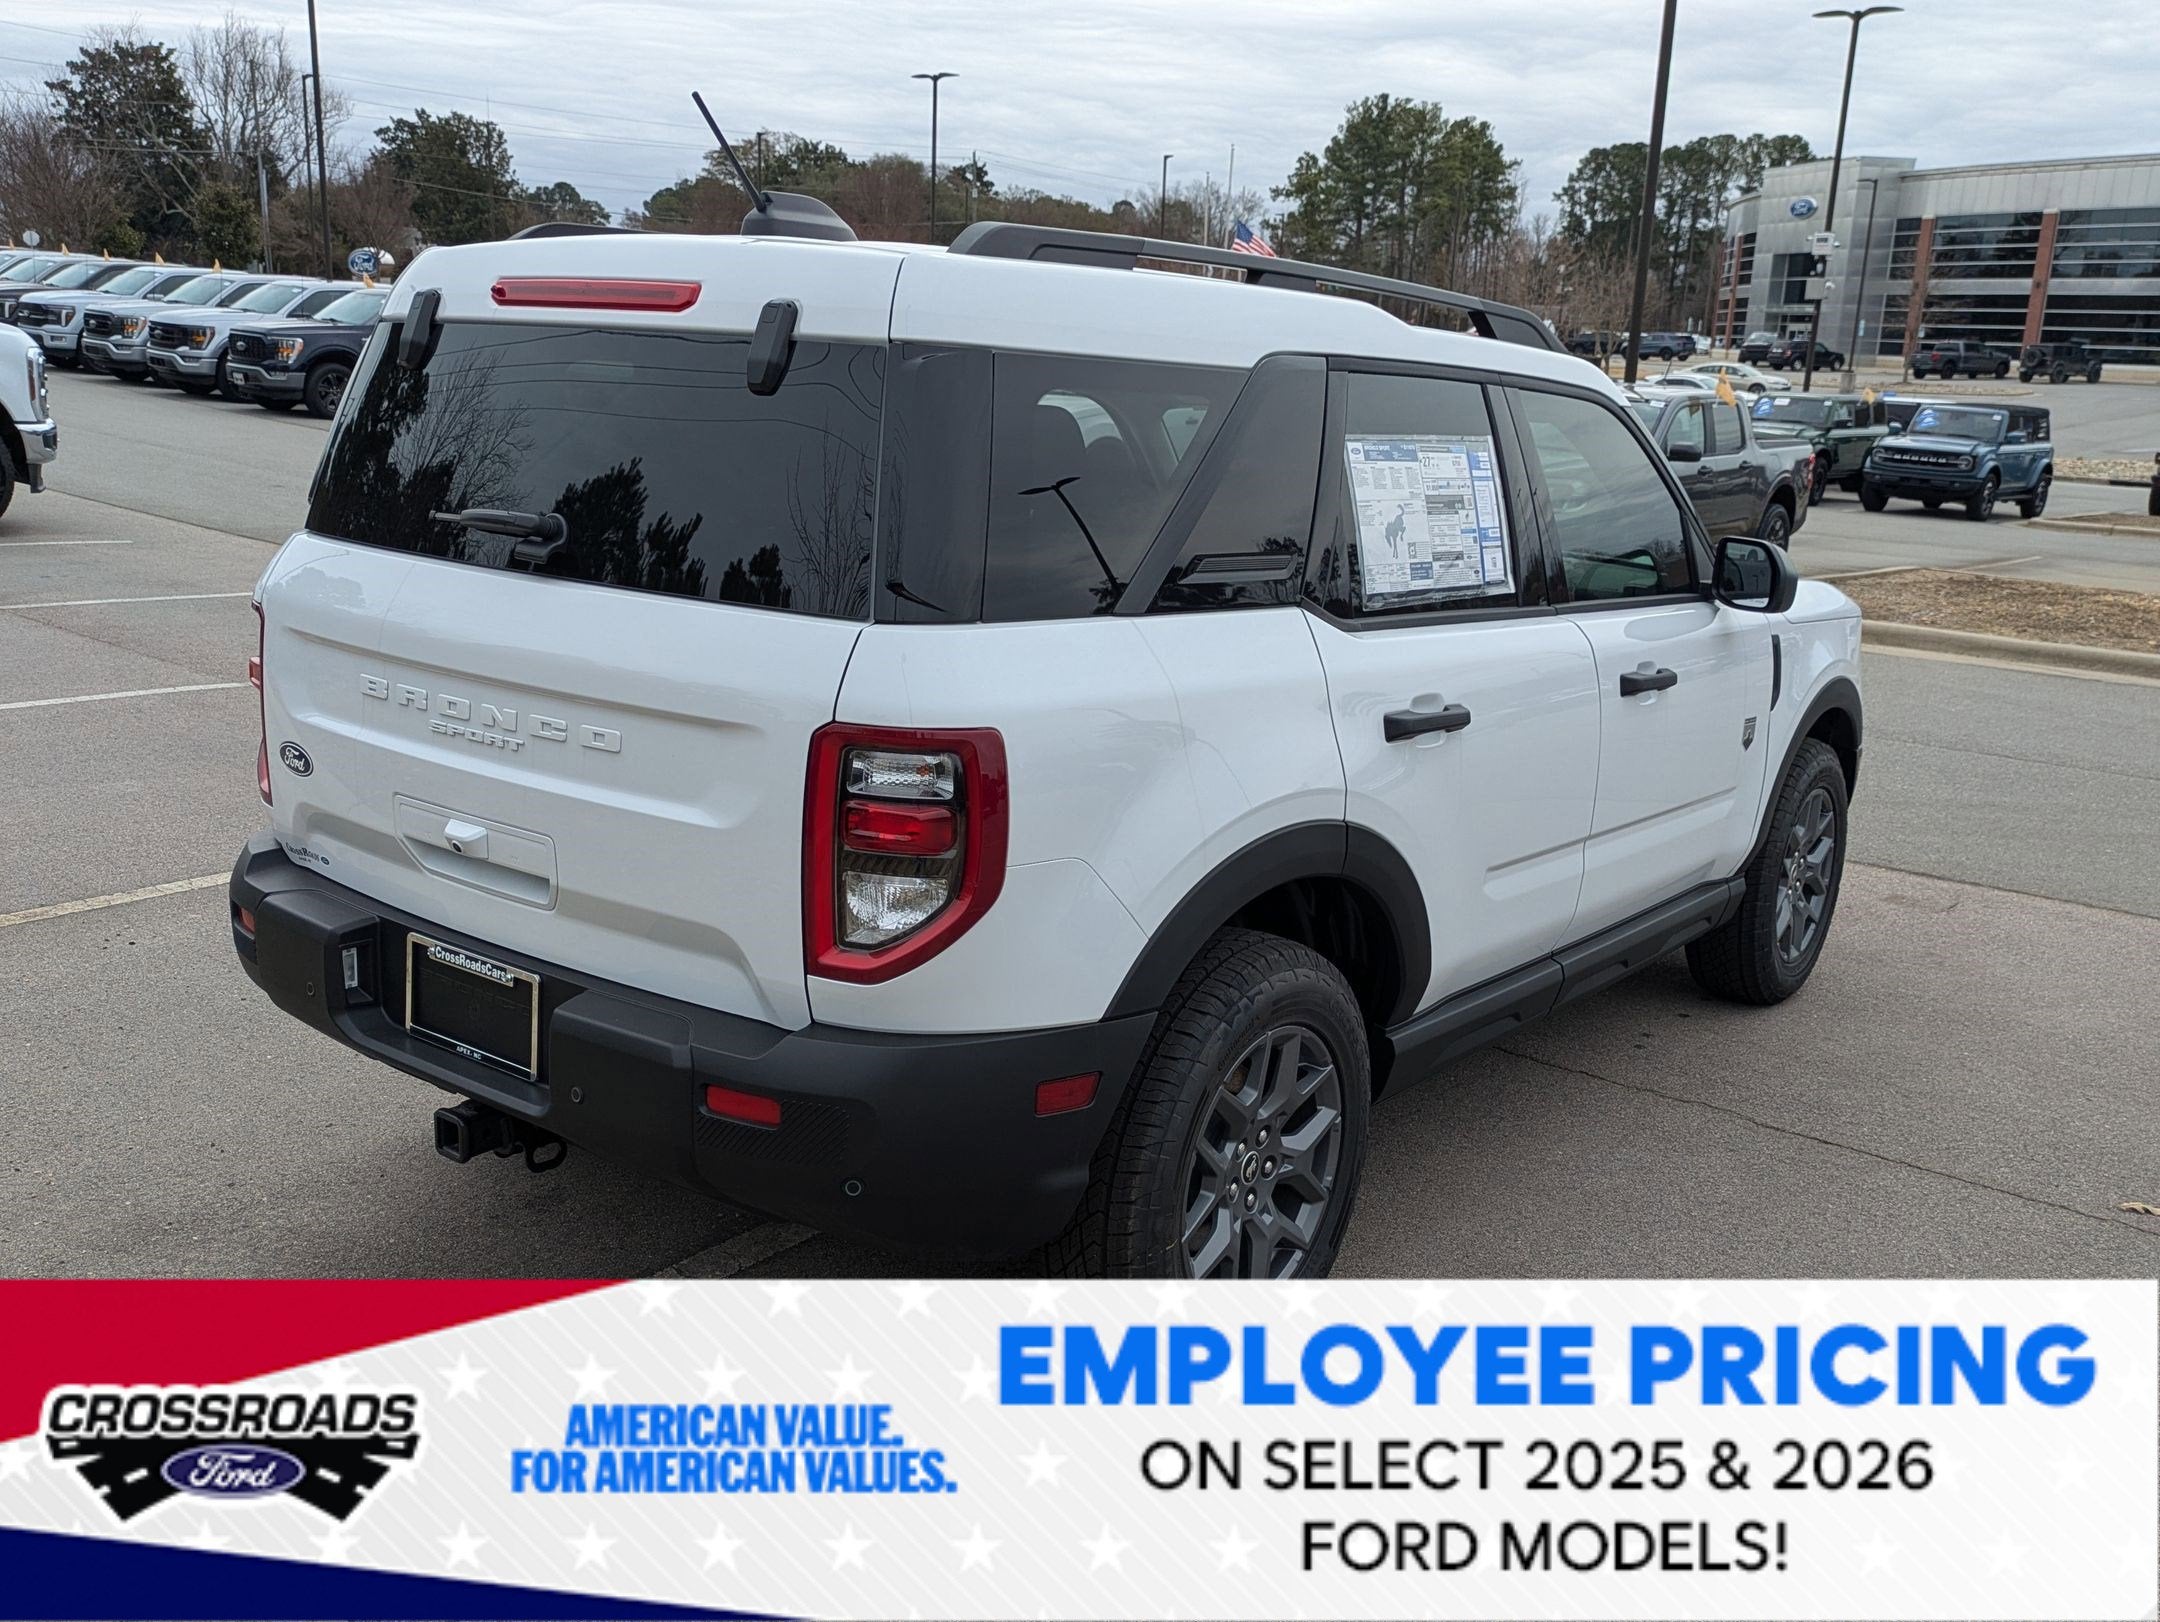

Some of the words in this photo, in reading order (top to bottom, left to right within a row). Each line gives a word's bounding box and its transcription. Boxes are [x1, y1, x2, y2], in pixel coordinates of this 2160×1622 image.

[360, 673, 622, 753] BRONCO
[428, 719, 525, 751] SPORT
[285, 747, 306, 772] Ford
[435, 946, 507, 981] CrossRoadsCars
